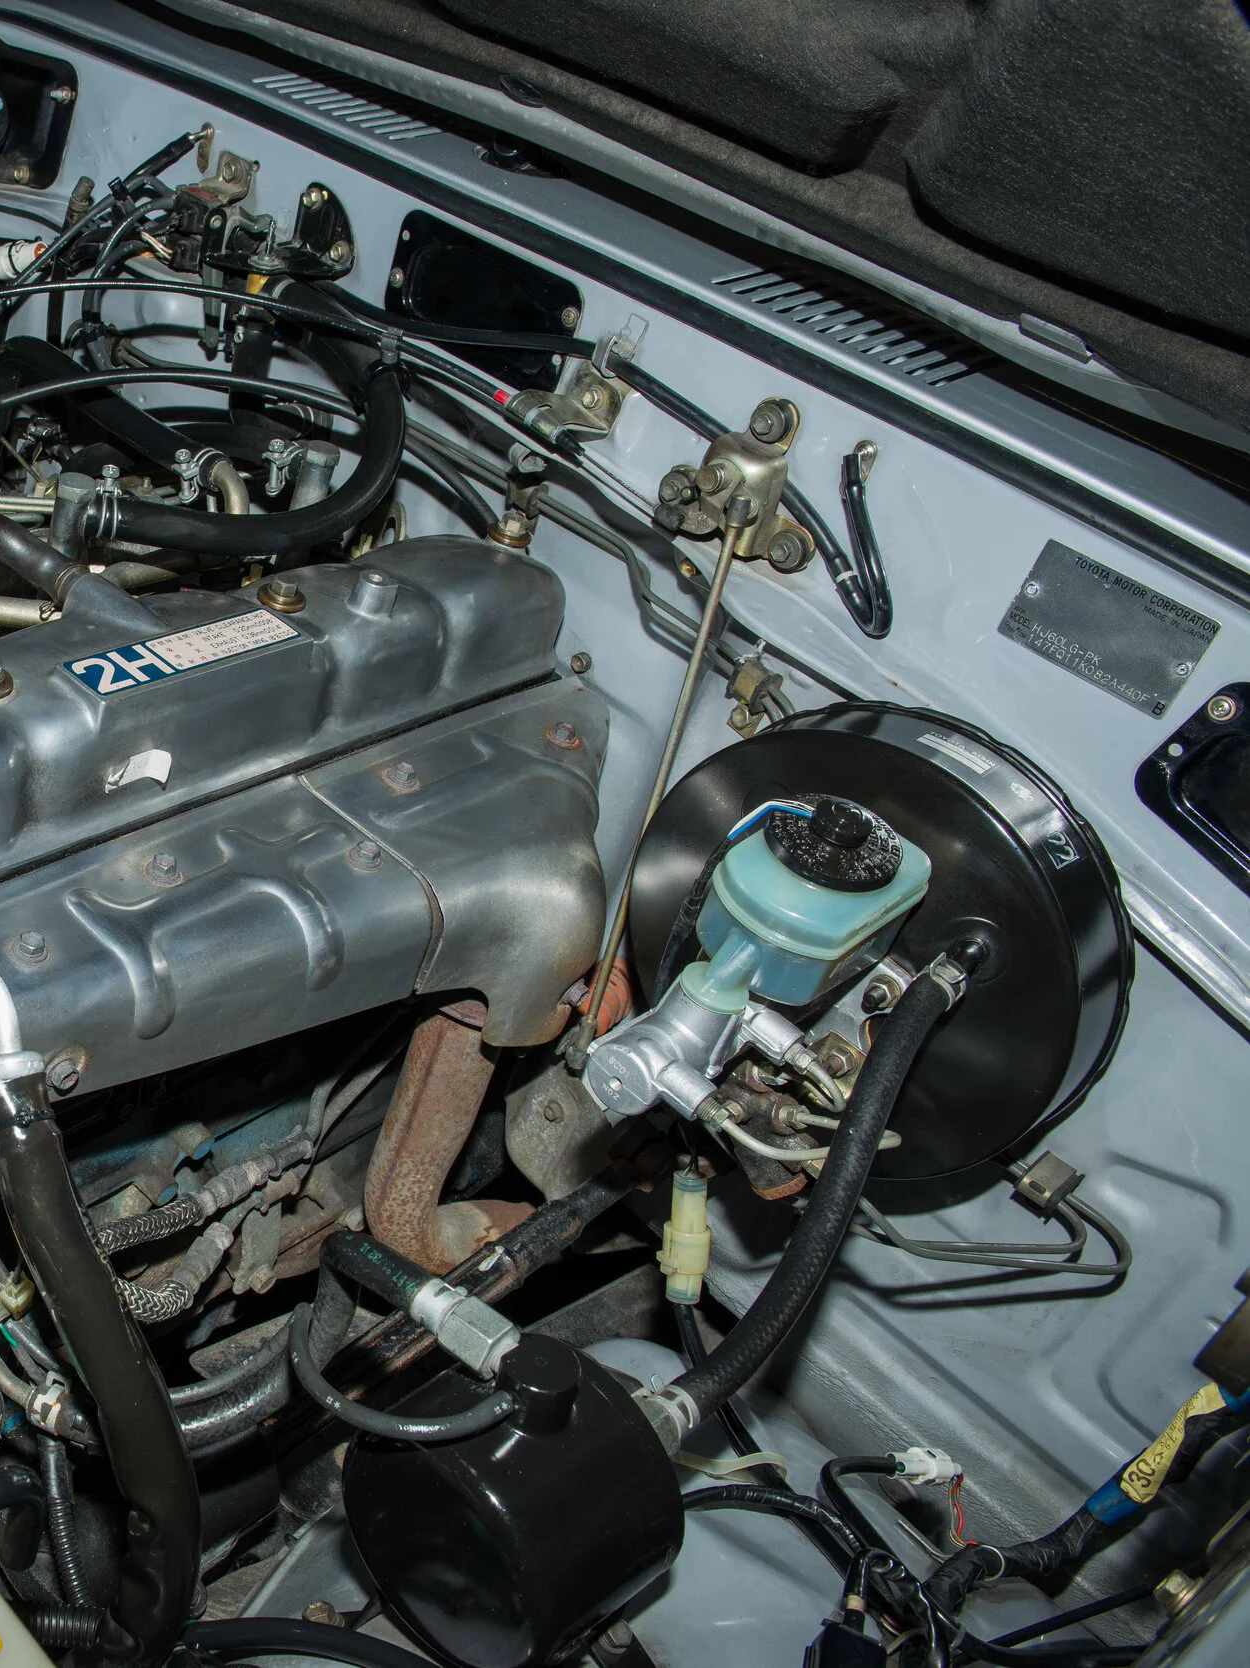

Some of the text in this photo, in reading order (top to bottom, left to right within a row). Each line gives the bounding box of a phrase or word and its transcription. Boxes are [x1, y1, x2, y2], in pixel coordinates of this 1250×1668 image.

[1075, 557, 1219, 636] TOYOTA MOTOR CORPORATION
[1008, 611, 1031, 630] MODEL
[1143, 605, 1211, 645] MADE IN JAPAN
[71, 644, 175, 695] 2H
[1151, 701, 1166, 717] B
[930, 731, 996, 768] TOYOTA AISIN
